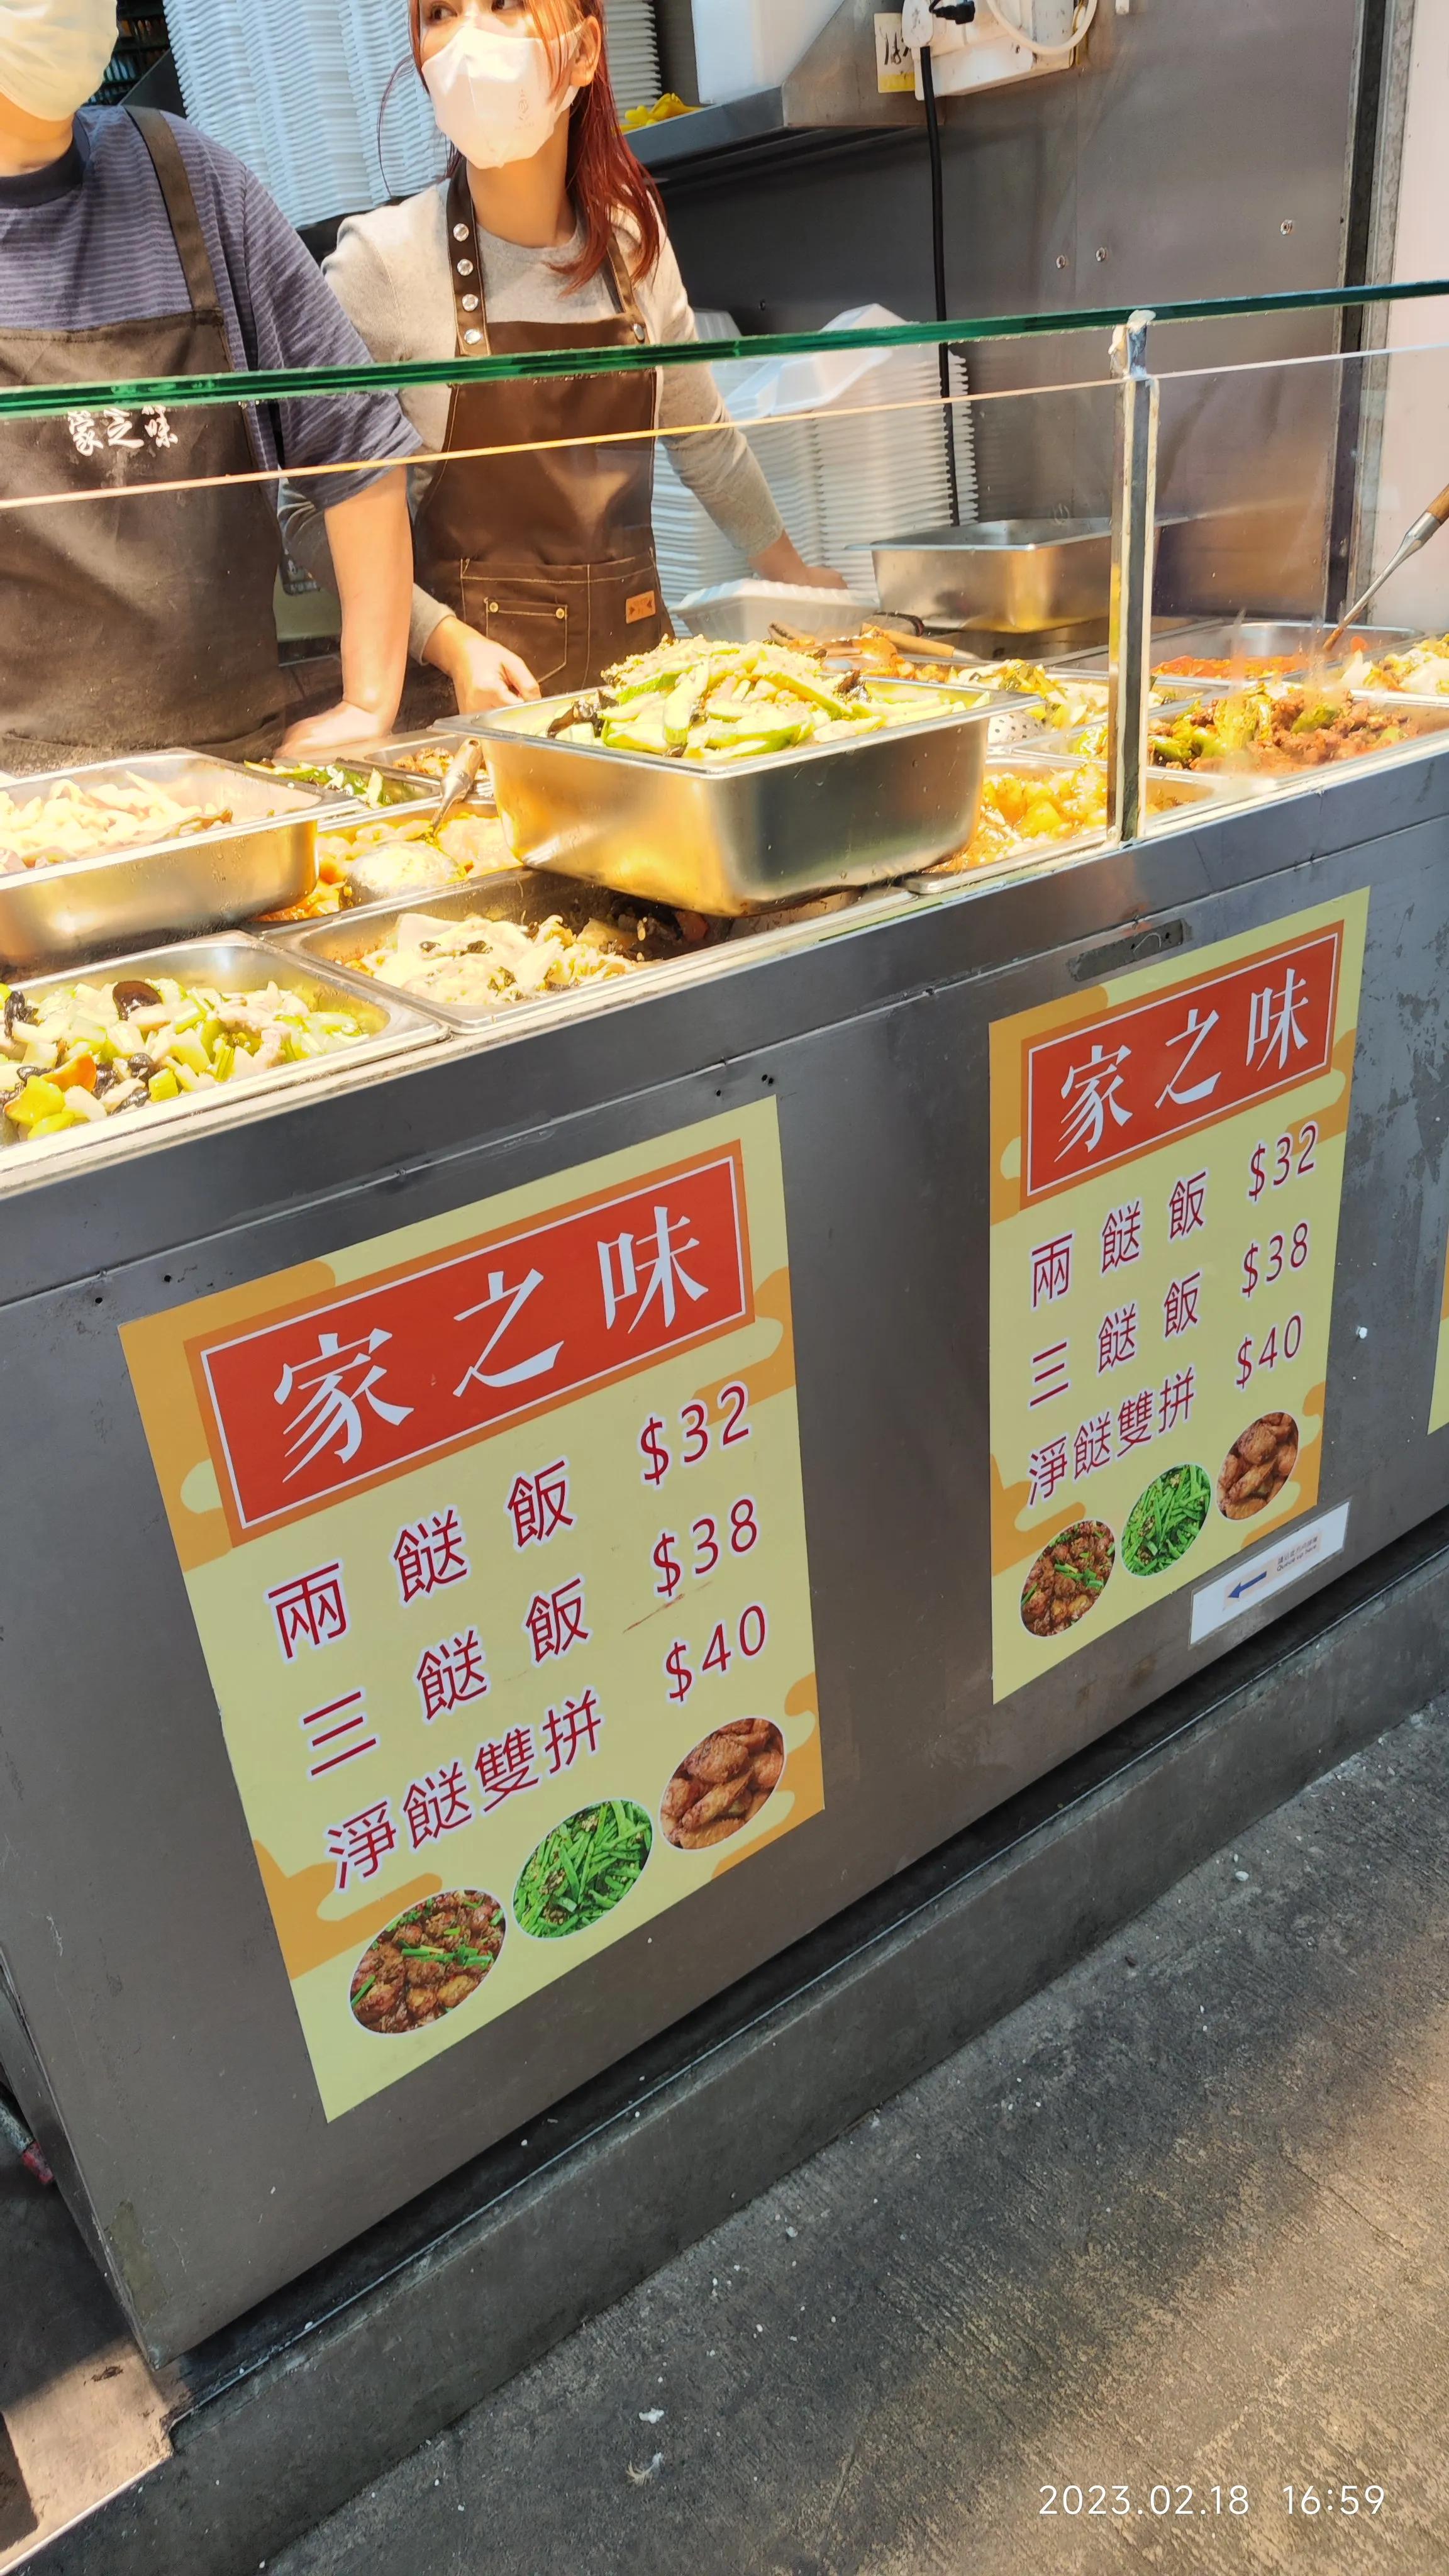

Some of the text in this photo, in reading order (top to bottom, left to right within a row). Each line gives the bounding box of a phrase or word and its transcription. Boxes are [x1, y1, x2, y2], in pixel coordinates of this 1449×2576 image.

[1054, 969, 1309, 1162] 家之味
[1030, 1223, 1307, 1406] 三餸飯 $38
[1031, 1125, 1316, 1307] 兩餸飯 $32
[274, 1206, 708, 1482] 家之味
[1029, 1316, 1301, 1505] 淨餸雙拼 $40
[269, 1386, 749, 1658] 兩餸飯 $32
[303, 1499, 757, 1775] 三餸飯 $38
[328, 1606, 765, 1889] 淨餸雙拼 $40
